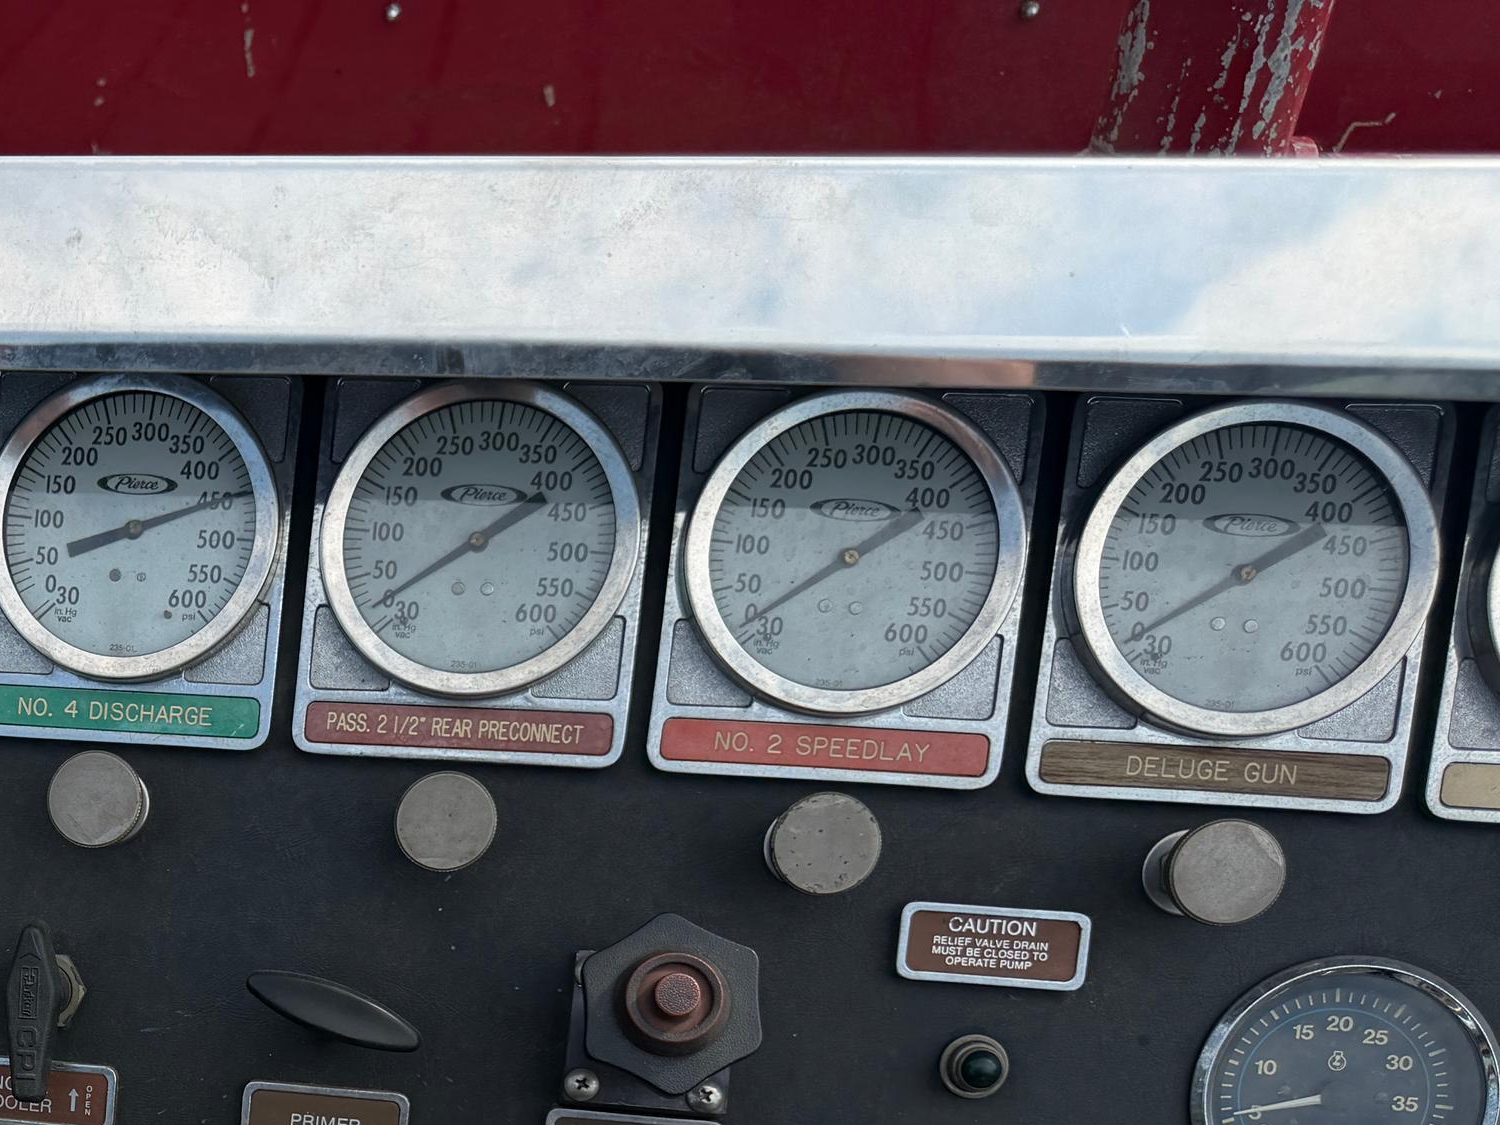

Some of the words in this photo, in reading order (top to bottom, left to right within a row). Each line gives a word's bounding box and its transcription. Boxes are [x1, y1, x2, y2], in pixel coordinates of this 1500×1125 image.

[131, 422, 170, 442] 300
[436, 435, 474, 456] 250
[852, 444, 896, 466] 300
[1160, 483, 1207, 506] 200
[34, 510, 64, 529] 100
[536, 578, 574, 597] 550
[1280, 642, 1328, 664] 600
[17, 696, 53, 717] NO.
[64, 699, 79, 719] 4
[89, 700, 213, 727] DISCHARGE
[327, 711, 370, 733] PASS.
[377, 714, 388, 733] 2
[431, 717, 474, 738] REAR
[478, 719, 584, 745] PRECONNECT
[714, 731, 753, 752] NO.
[767, 734, 782, 755] 2
[796, 736, 931, 763] SPEEDLAY
[1126, 754, 1230, 782] DELUGE
[1243, 760, 1298, 786] GUN
[949, 916, 1037, 937] CAUTION
[933, 935, 972, 946] RELIEF
[975, 938, 1010, 949] VALVE
[1013, 940, 1049, 951] DRAIN
[931, 945, 962, 956] MUST
[966, 948, 981, 957] BE
[984, 949, 1029, 961] CLOSED
[1032, 952, 1048, 961] TO
[945, 956, 997, 968] OPERATE
[999, 959, 1033, 970] PUMP
[1293, 1024, 1315, 1041] 15
[1326, 1015, 1353, 1032] 20
[1362, 1029, 1388, 1046] 25
[1255, 1059, 1277, 1076] 10
[1386, 1054, 1413, 1071] 30
[84, 1085, 93, 1116] OPEN
[1391, 1095, 1419, 1112] 35
